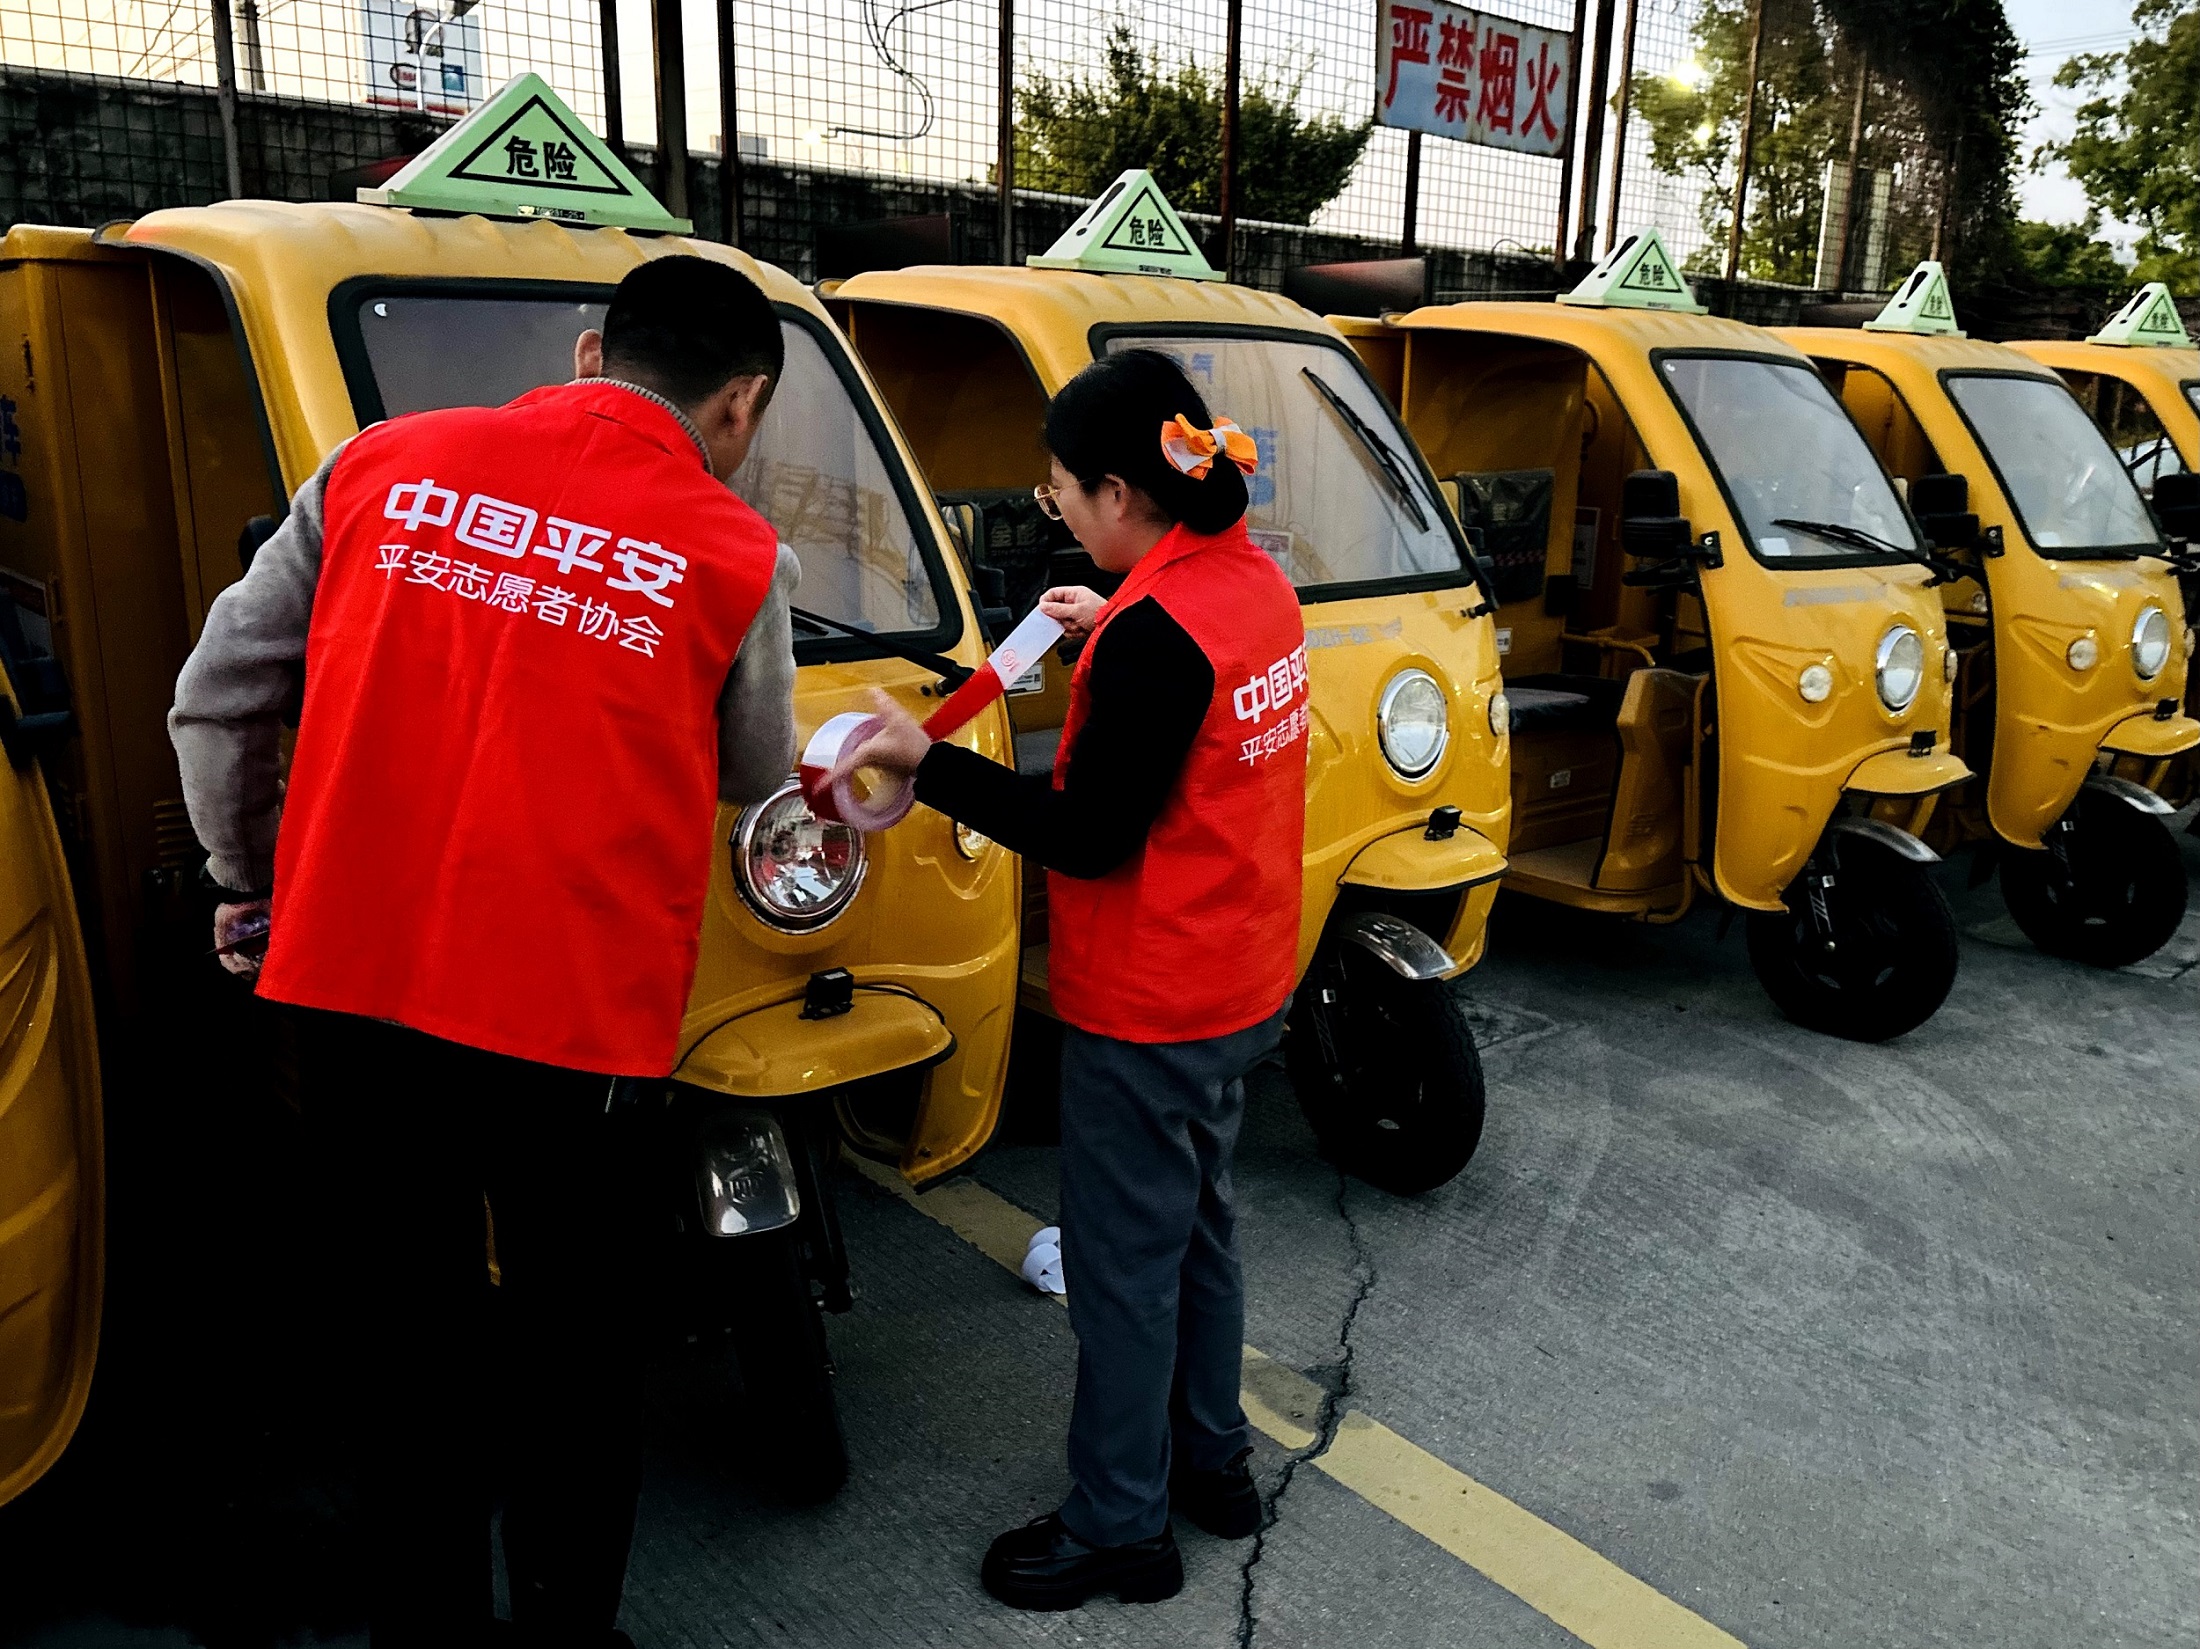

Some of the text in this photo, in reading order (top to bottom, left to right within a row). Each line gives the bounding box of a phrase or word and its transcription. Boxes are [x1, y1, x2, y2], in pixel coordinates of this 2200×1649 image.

[1384, 4, 1561, 143] 严禁烟火
[504, 135, 578, 181] 危险
[1129, 215, 1165, 247] 危险
[384, 479, 688, 608] 中国平安
[375, 544, 664, 658] 平安志愿者协会
[1233, 641, 1309, 724] 中国平
